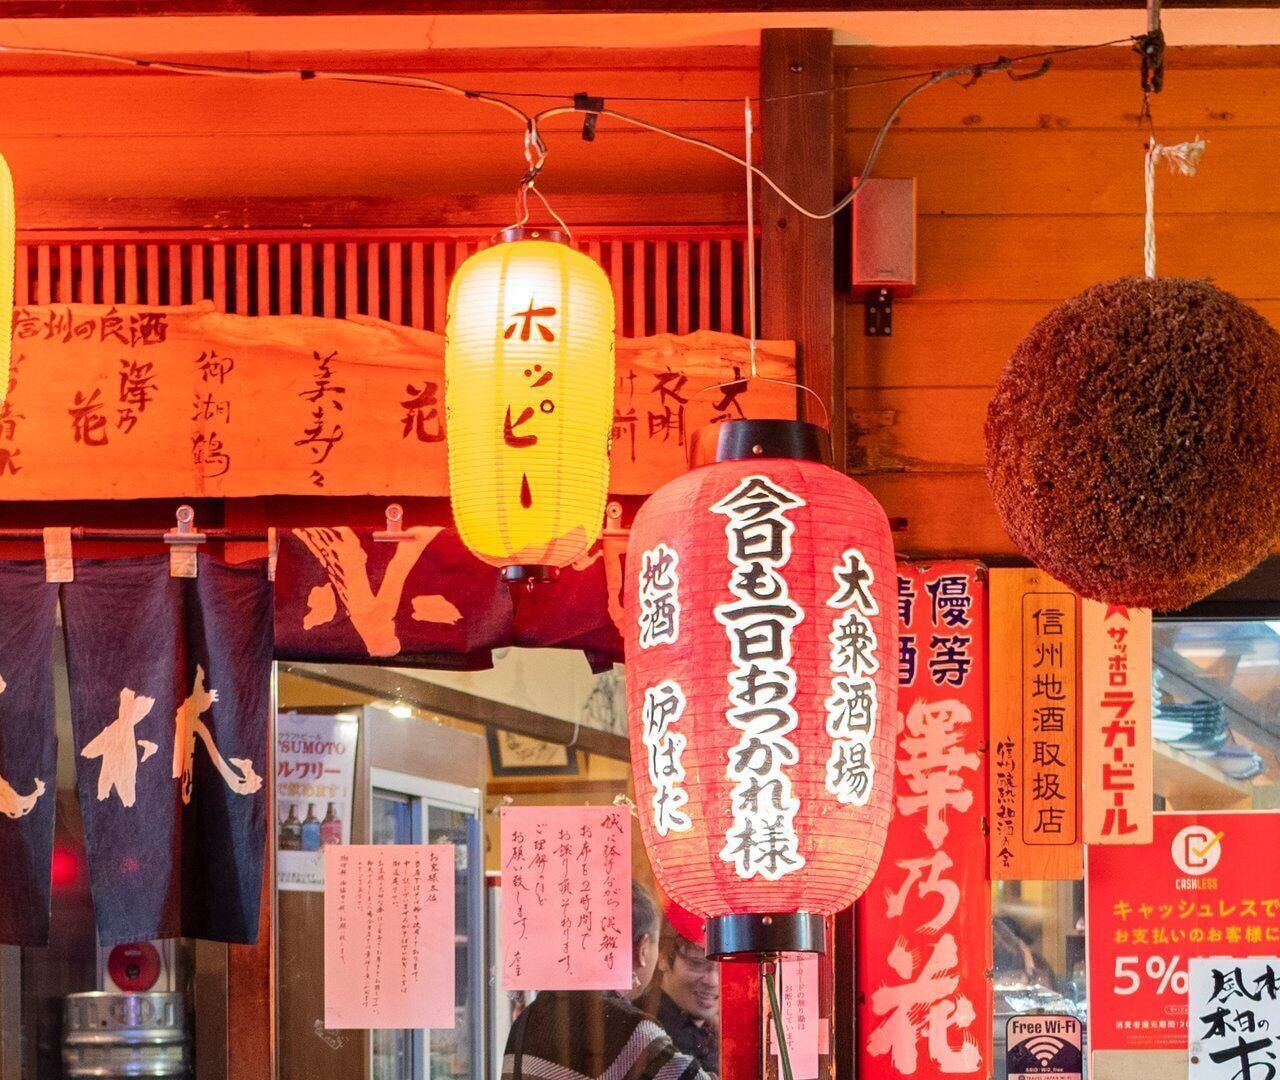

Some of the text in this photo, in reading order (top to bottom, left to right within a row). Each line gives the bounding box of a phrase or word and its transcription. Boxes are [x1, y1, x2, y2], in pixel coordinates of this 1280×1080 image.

[504, 292, 557, 510] ホッピー
[648, 366, 688, 447] 夜明
[642, 546, 686, 827] 地酒 炉ばた
[718, 477, 800, 876] 今日も一日おつかれ様
[833, 554, 876, 800] 大衆酒場
[925, 574, 972, 687] 優等
[1031, 607, 1067, 835] 信州地酒取扱店
[1100, 626, 1139, 837] サッポロラガービール
[1113, 926, 1280, 945] お支払いのお客様に
[1175, 878, 1218, 891] CASHLESS
[1012, 1020, 1076, 1034] Free Wi-Fi
[1200, 1006, 1270, 1042] 本日の
